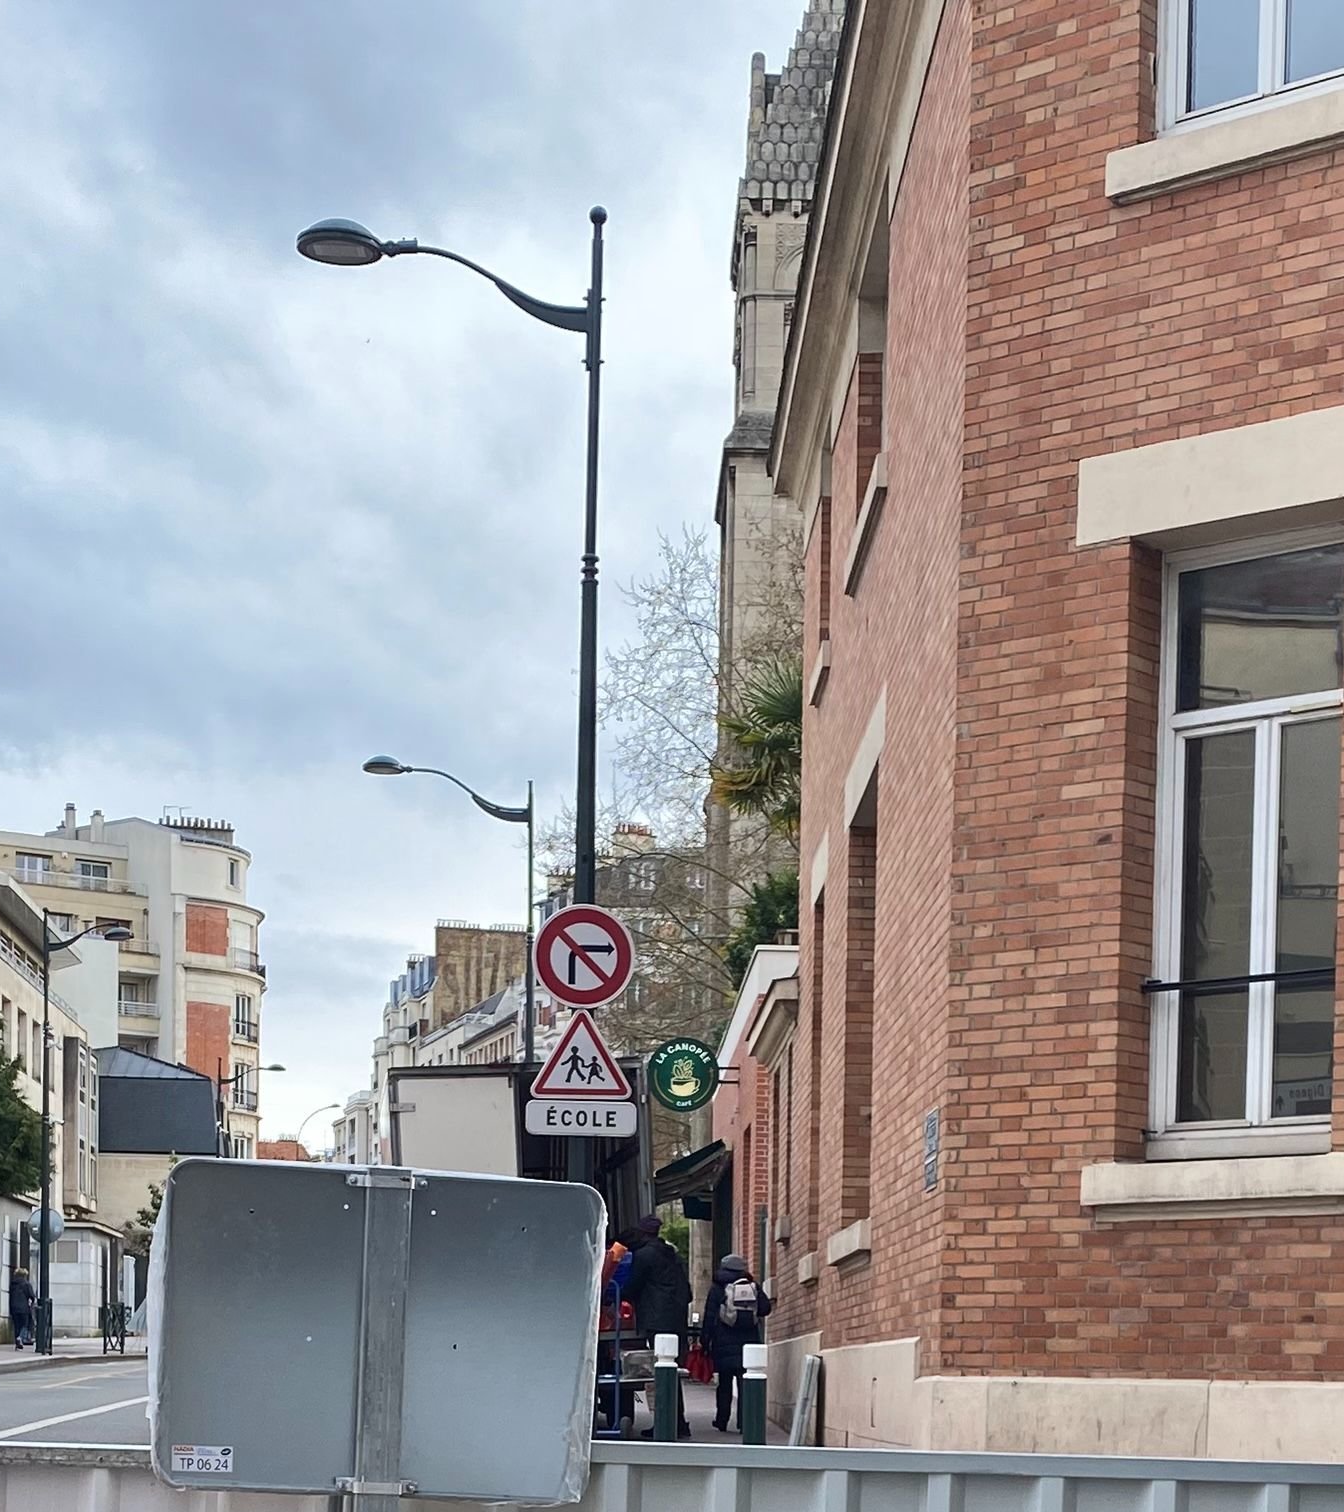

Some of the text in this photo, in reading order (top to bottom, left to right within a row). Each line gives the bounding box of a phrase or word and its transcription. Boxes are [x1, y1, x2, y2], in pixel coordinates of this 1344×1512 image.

[655, 1042, 711, 1064] LA CANOPÉE
[546, 1106, 617, 1128] ÉCOLE
[180, 1457, 228, 1470] TP 06 24
